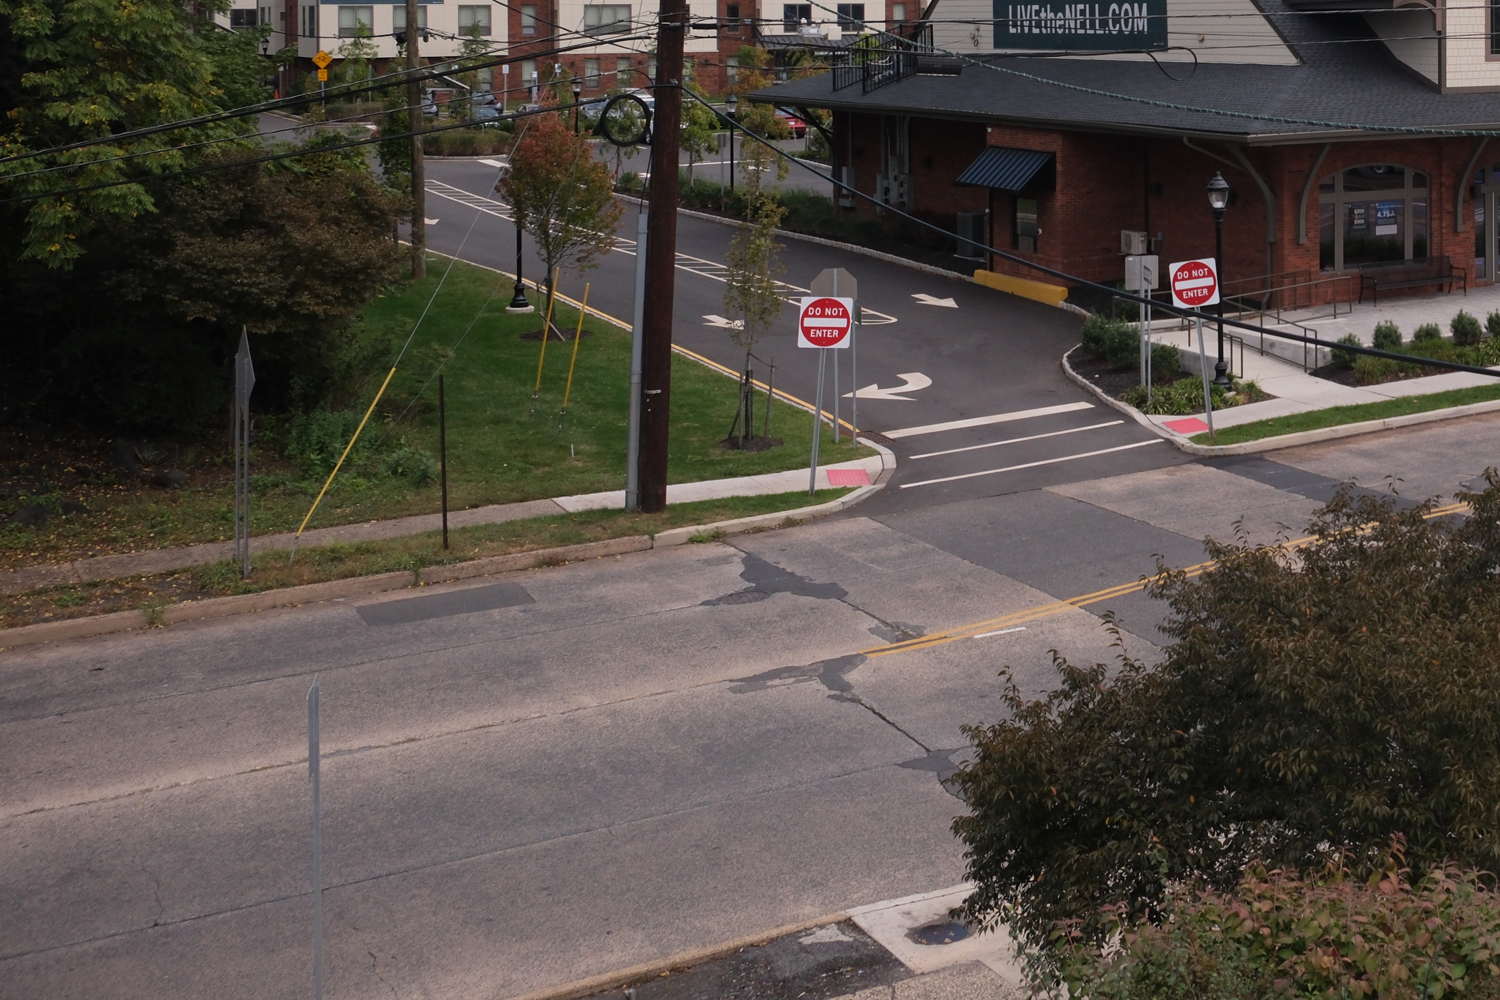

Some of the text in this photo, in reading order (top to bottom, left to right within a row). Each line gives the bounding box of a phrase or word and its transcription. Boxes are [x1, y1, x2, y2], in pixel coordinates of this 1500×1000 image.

[1008, 2, 1148, 35] LIVEtheNELL.COM
[1177, 268, 1209, 280] DO NOT
[1183, 288, 1209, 299] ENTER
[808, 307, 844, 316] DO NOT
[810, 329, 839, 338] ENTER
